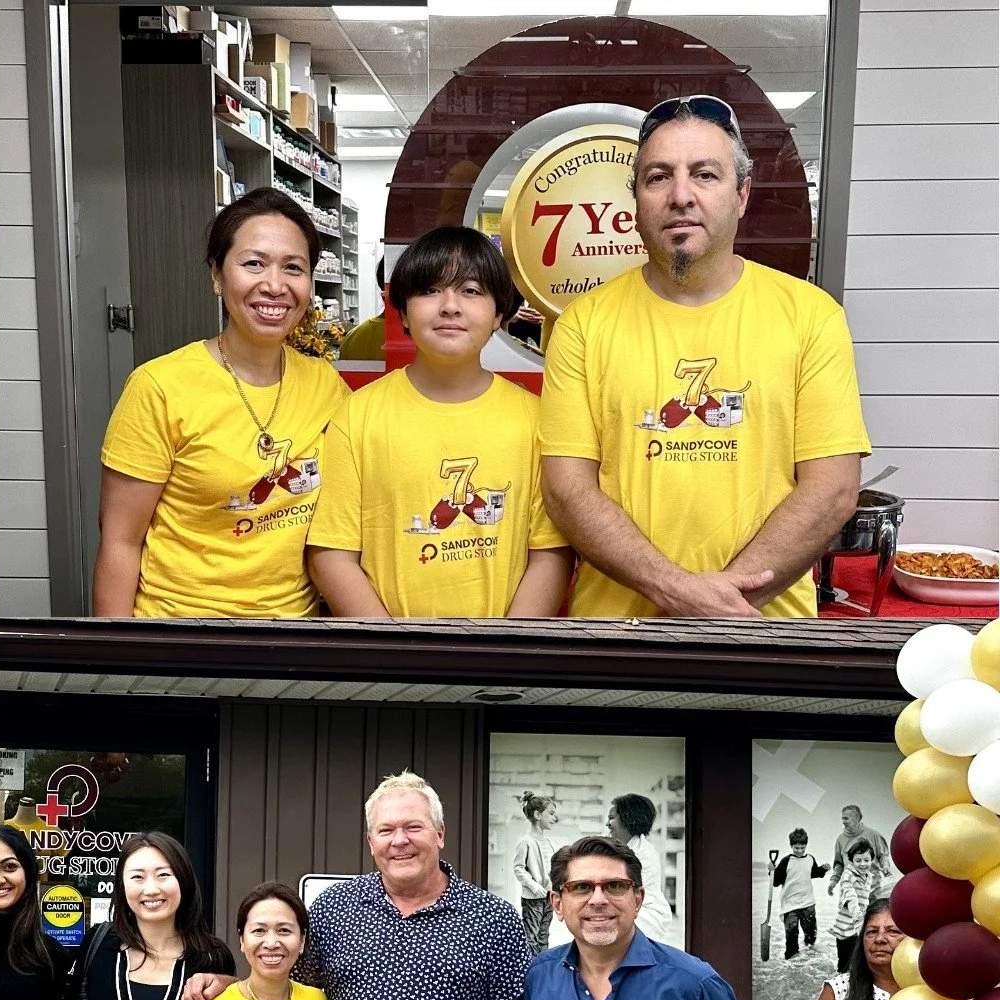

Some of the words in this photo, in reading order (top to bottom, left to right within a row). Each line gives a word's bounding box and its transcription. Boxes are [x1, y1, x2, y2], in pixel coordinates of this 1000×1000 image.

[534, 145, 637, 194] Congratulat
[531, 200, 573, 267] 7
[579, 202, 640, 235] Ye
[666, 440, 738, 451] SANDYCOVE
[665, 451, 697, 462] DRUG
[700, 451, 738, 462] STORE
[257, 502, 317, 525] SANDYCOV
[256, 520, 286, 534] DRUG
[442, 550, 473, 562] DRUG
[46, 903, 80, 911] CAUTION
